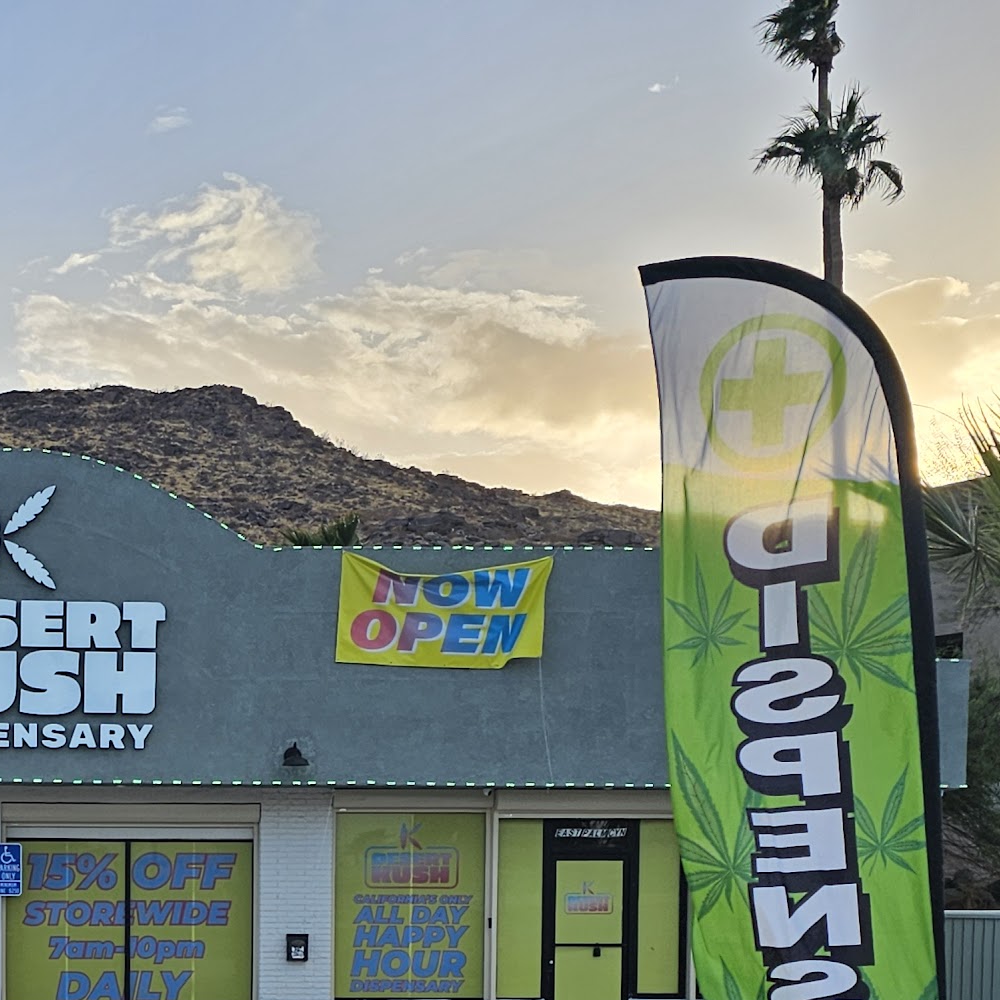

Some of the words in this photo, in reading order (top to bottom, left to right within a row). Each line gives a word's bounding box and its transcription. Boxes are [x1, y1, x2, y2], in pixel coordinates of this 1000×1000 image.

[371, 567, 533, 609] NOW
[350, 609, 529, 656] OPEN
[554, 828, 582, 838] EAST
[27, 852, 119, 890] 15%
[131, 852, 238, 890] OFF
[371, 865, 450, 884] KUSH
[353, 894, 438, 905] CALIFORNIA'S
[439, 894, 474, 905] ONLY
[23, 900, 232, 927] STOREWIDE
[352, 905, 405, 924] ALL
[410, 905, 470, 925] DAY
[353, 925, 470, 948] HAPPY
[49, 935, 206, 965] 7am-10pm
[350, 949, 467, 978] HOUR
[349, 979, 465, 993] DISPENSARY
